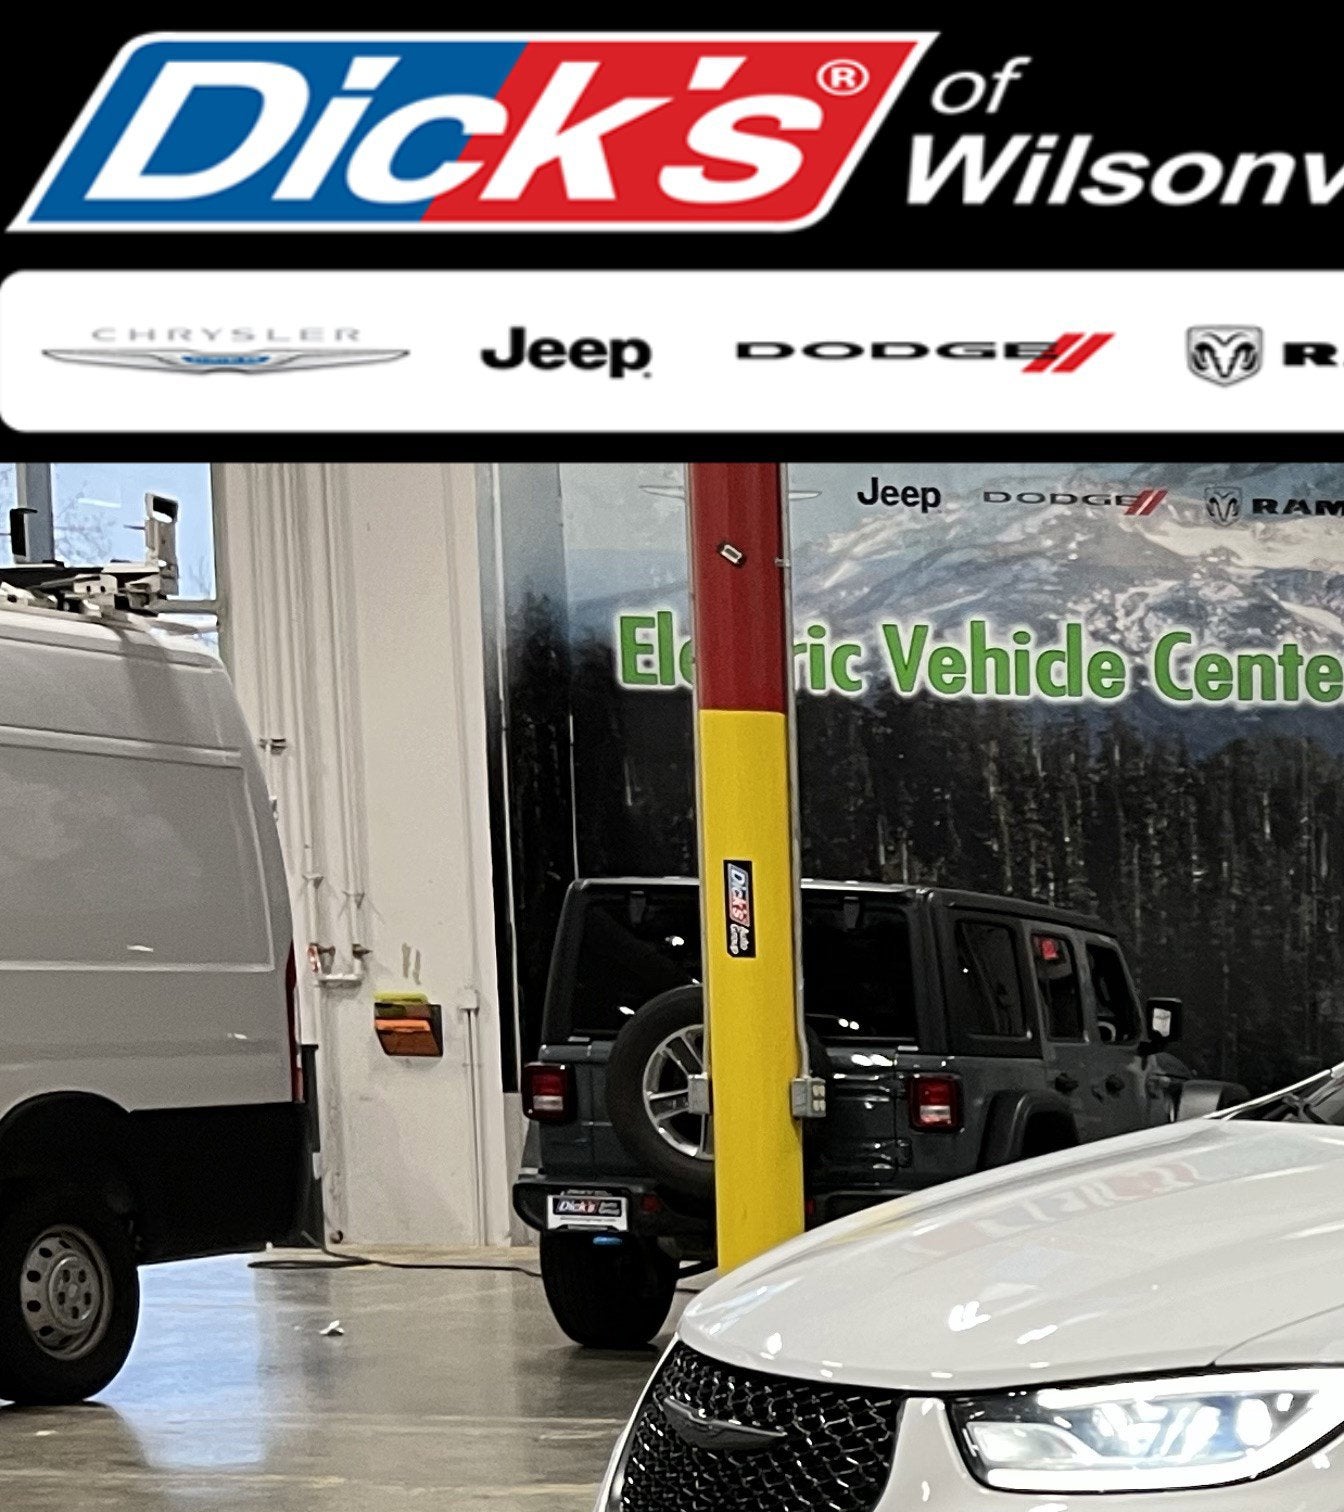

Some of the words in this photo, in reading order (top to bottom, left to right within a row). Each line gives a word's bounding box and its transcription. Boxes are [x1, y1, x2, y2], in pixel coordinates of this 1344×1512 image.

[856, 476, 942, 514] Jeep
[983, 491, 1142, 508] DODGE
[882, 620, 1125, 698] Vehicle
